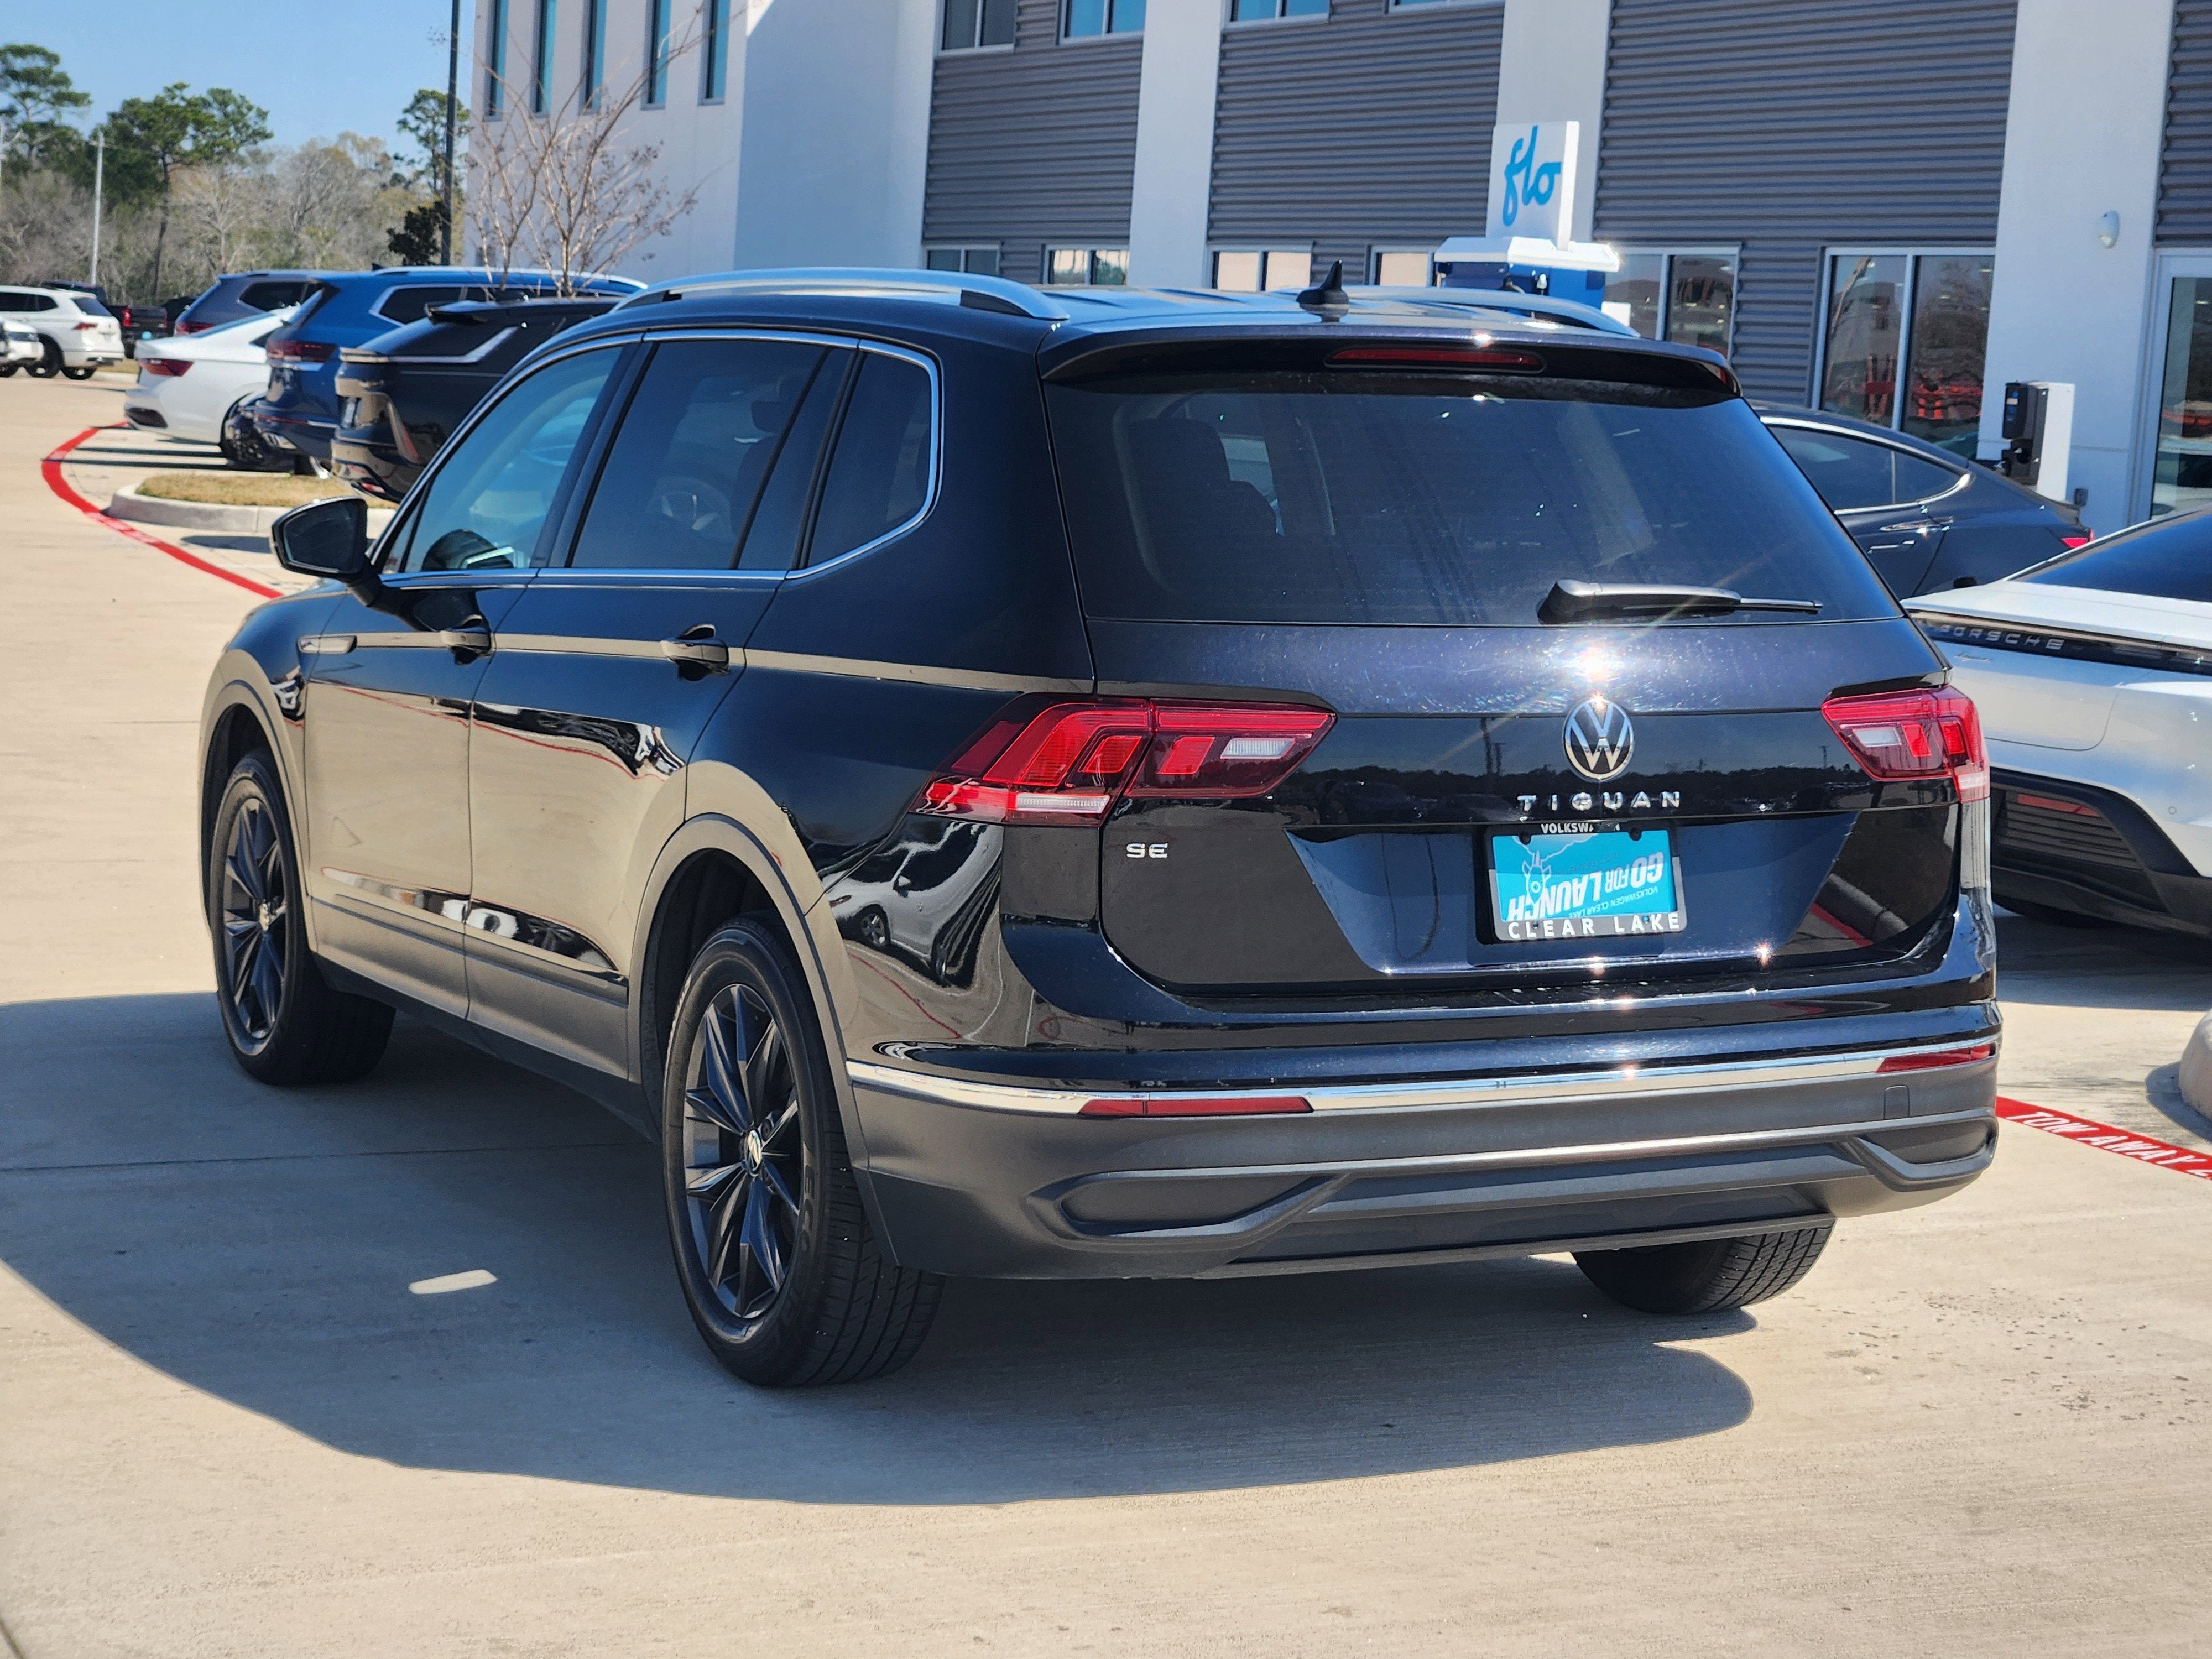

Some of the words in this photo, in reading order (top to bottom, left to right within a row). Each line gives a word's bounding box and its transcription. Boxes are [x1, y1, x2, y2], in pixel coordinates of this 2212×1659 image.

[1502, 125, 1562, 227] flo
[1938, 624, 2064, 650] PORSCHE
[1517, 791, 1680, 811] TIGUAN
[1126, 843, 1168, 859] SE
[1604, 864, 1630, 893] FOR
[1631, 852, 1664, 888] GO
[1508, 871, 1602, 921] LAUNCH
[1587, 901, 1609, 915] CLEAR
[1610, 885, 1658, 907] VOLKSWAGEN
[1507, 918, 1595, 939] CLEAR
[1613, 912, 1680, 933] LAKE
[2006, 1111, 2100, 1133] TOW
[2075, 1135, 2207, 1165] AWAY
